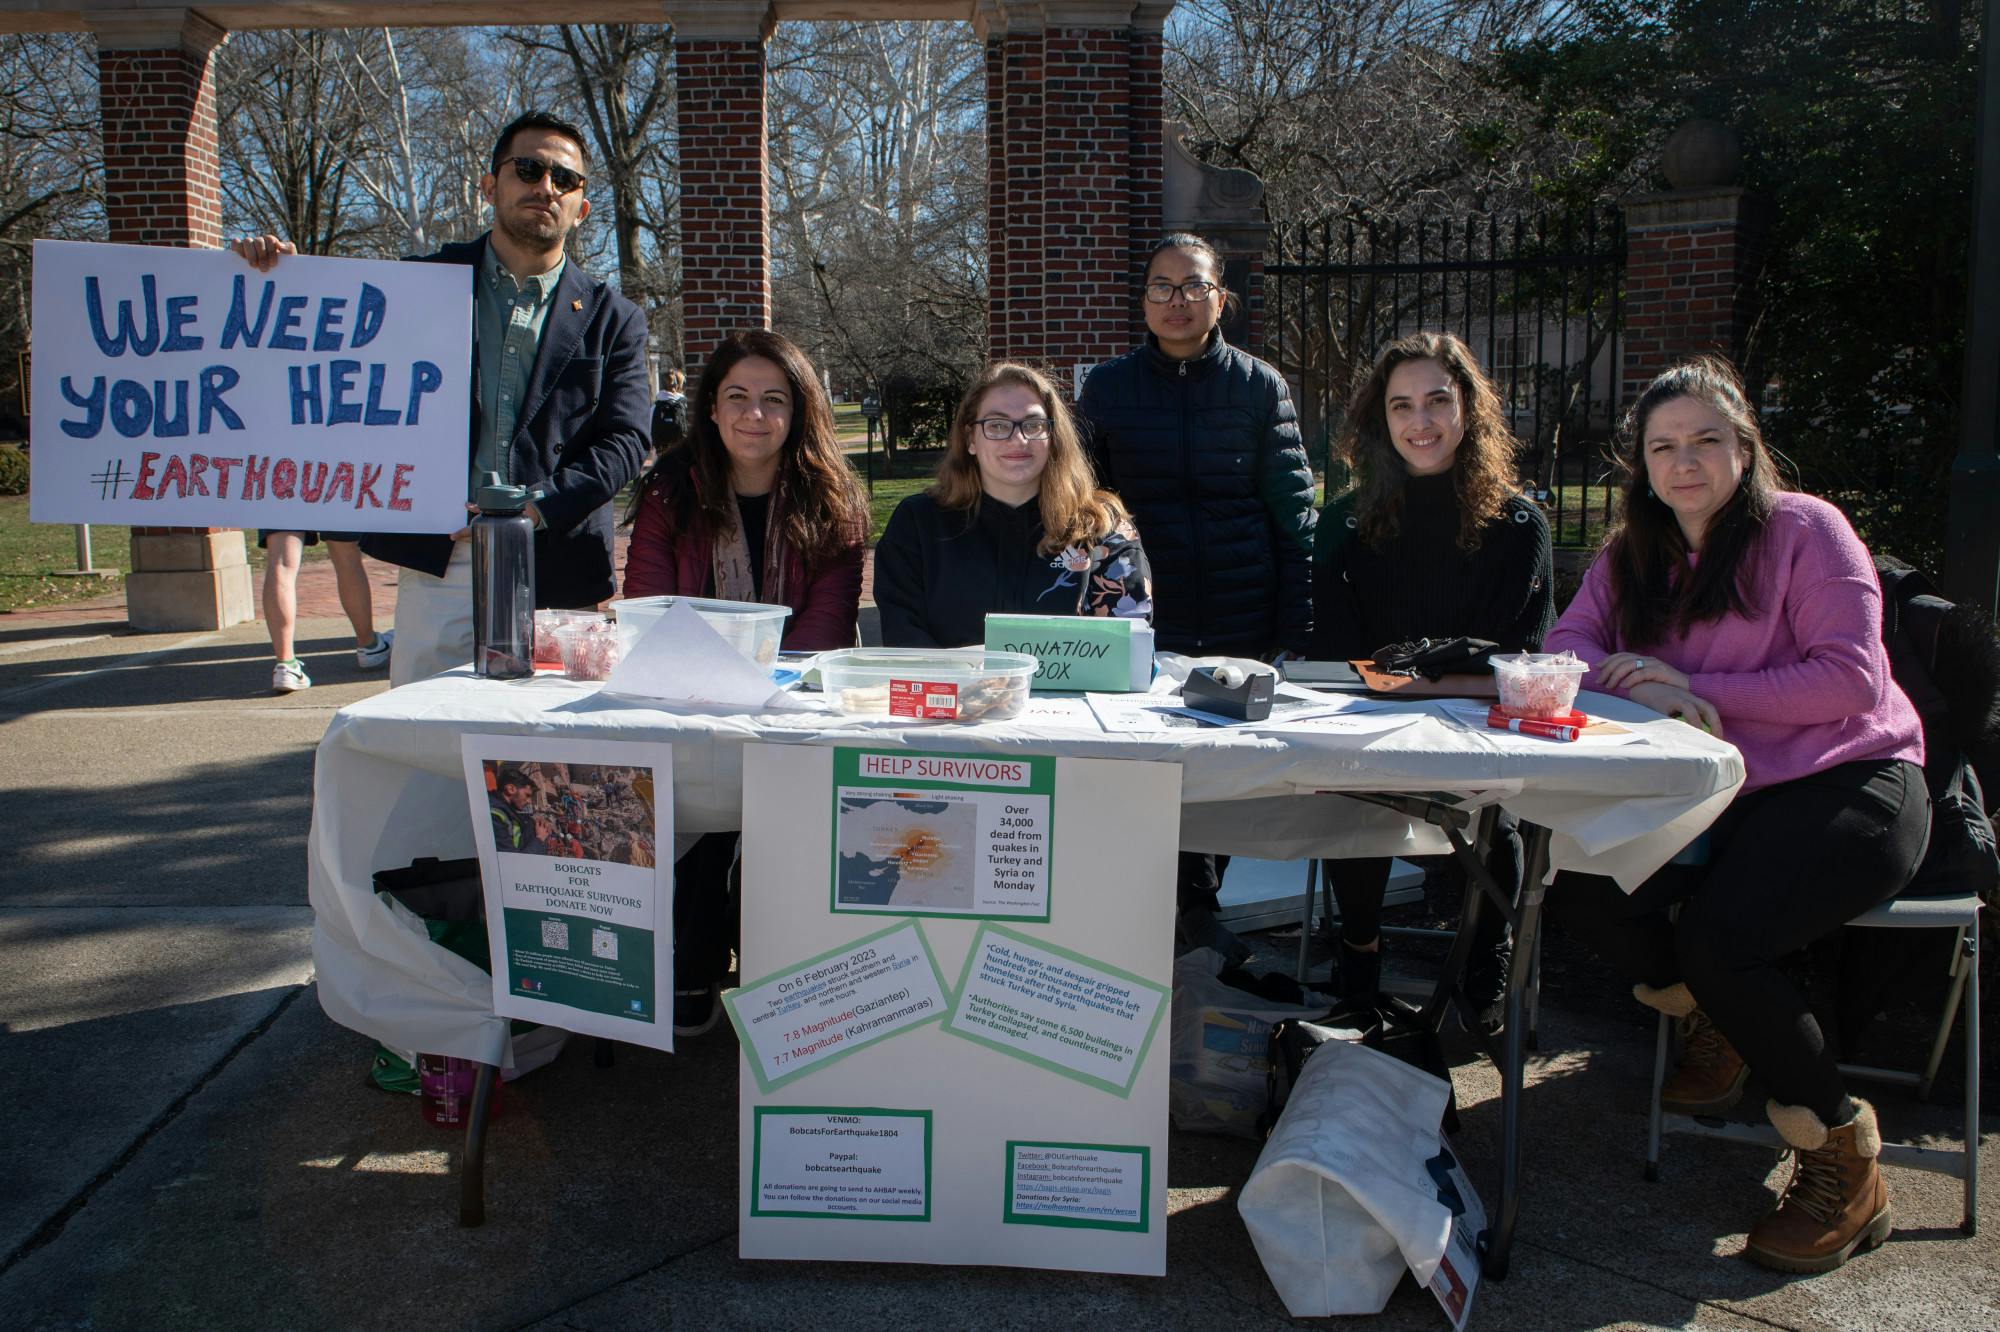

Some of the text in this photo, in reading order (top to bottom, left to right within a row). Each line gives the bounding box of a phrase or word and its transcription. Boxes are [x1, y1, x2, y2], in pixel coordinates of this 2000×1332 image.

[85, 274, 387, 358] WE NEED
[59, 364, 245, 439] YOUR
[288, 359, 443, 427] HELP
[91, 452, 415, 512] #EARTHQUAKE
[1004, 639, 1110, 658] DONATION
[867, 757, 1022, 781] HELP SURVIVORS
[1005, 805, 1029, 814] Over
[1000, 818, 1033, 828] 34,000
[990, 830, 1041, 840] dead from
[992, 844, 1039, 852] quakes in
[988, 855, 1020, 866] Turkey
[555, 864, 601, 875] BOBCATS
[995, 868, 1018, 878] Syria
[569, 877, 590, 886] FOR
[994, 881, 1035, 892] Monday
[516, 883, 642, 908] EARTHQUAKE SURVIVORS
[546, 899, 614, 916] DONATE NOW
[778, 949, 876, 993] On 6 February 2023
[990, 944, 1130, 998] Cold, hunger, and despair gripped
[768, 954, 896, 1008] Two earthquakes struck southern and
[986, 953, 1141, 1012] hundreds of thousands of people left
[752, 1011, 776, 1024] central
[803, 993, 817, 1004] and
[818, 983, 847, 1000] northern
[849, 976, 862, 987] and
[863, 966, 892, 980] western
[892, 958, 911, 971] Syria
[980, 972, 1078, 1012] struck Turkey and Syria.
[983, 962, 1134, 1020] homeless after the earthquakes that
[819, 997, 835, 1008] nine
[774, 997, 933, 1065] 7.7 Magnitude (Kahramanmaras)
[965, 1014, 1029, 1040] were damaged.
[972, 994, 1018, 1016] Authorities
[1020, 1011, 1034, 1022] say
[1036, 1016, 1058, 1030] some
[1060, 1024, 1084, 1039] 6,500
[1085, 1032, 1123, 1053] buildings
[784, 1030, 800, 1042] 7.8
[968, 1004, 1123, 1062] Turkey collapsed, and countless more
[790, 1127, 898, 1137] BobcatsForEarthquake1804
[829, 1153, 858, 1161] Paypal:
[1018, 1152, 1044, 1160] Twitter:
[805, 1164, 881, 1174] bobcatsearthquake
[1017, 1162, 1122, 1174] Facebook: Bobcatsforearthquake
[1052, 1174, 1123, 1184] bobcatsforearthquake
